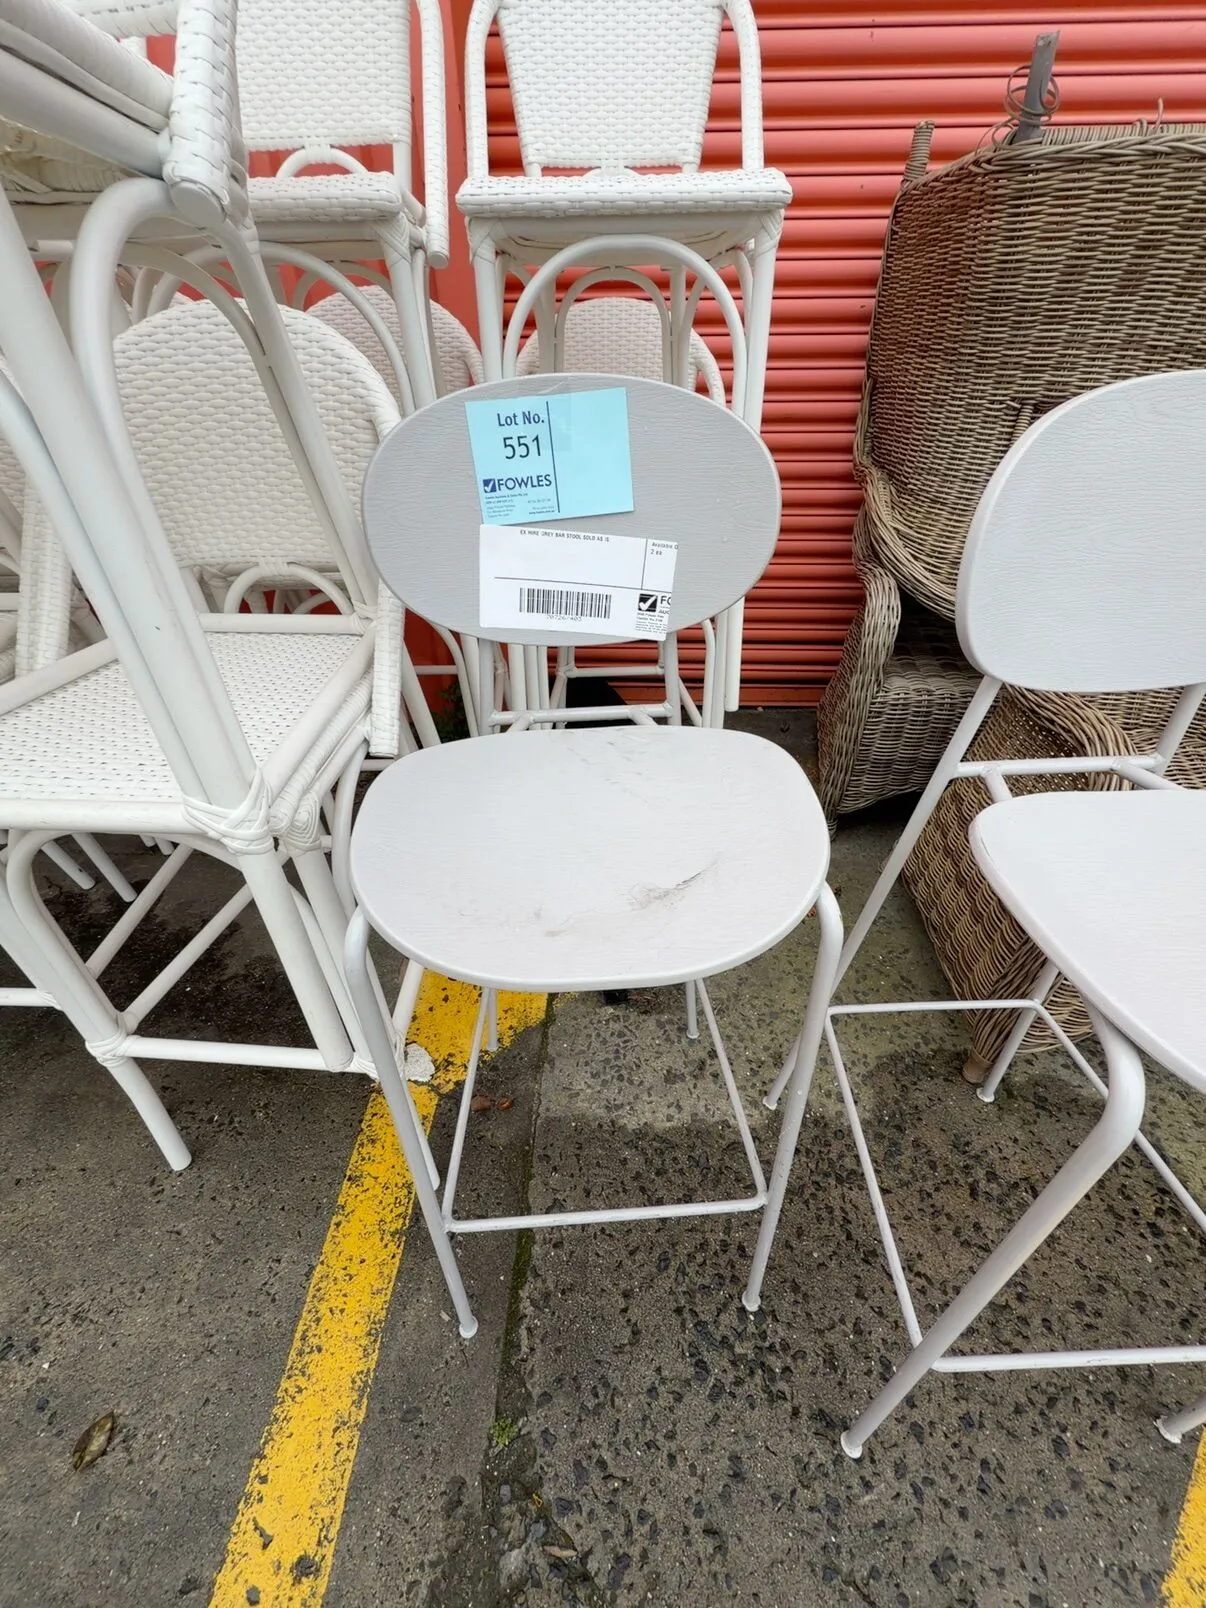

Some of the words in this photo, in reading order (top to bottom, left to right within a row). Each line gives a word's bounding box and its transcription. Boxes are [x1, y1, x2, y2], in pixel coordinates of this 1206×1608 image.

[497, 413, 518, 427] Lot
[522, 411, 545, 425] No.
[503, 434, 541, 460] 551
[497, 474, 552, 491] FOWLES
